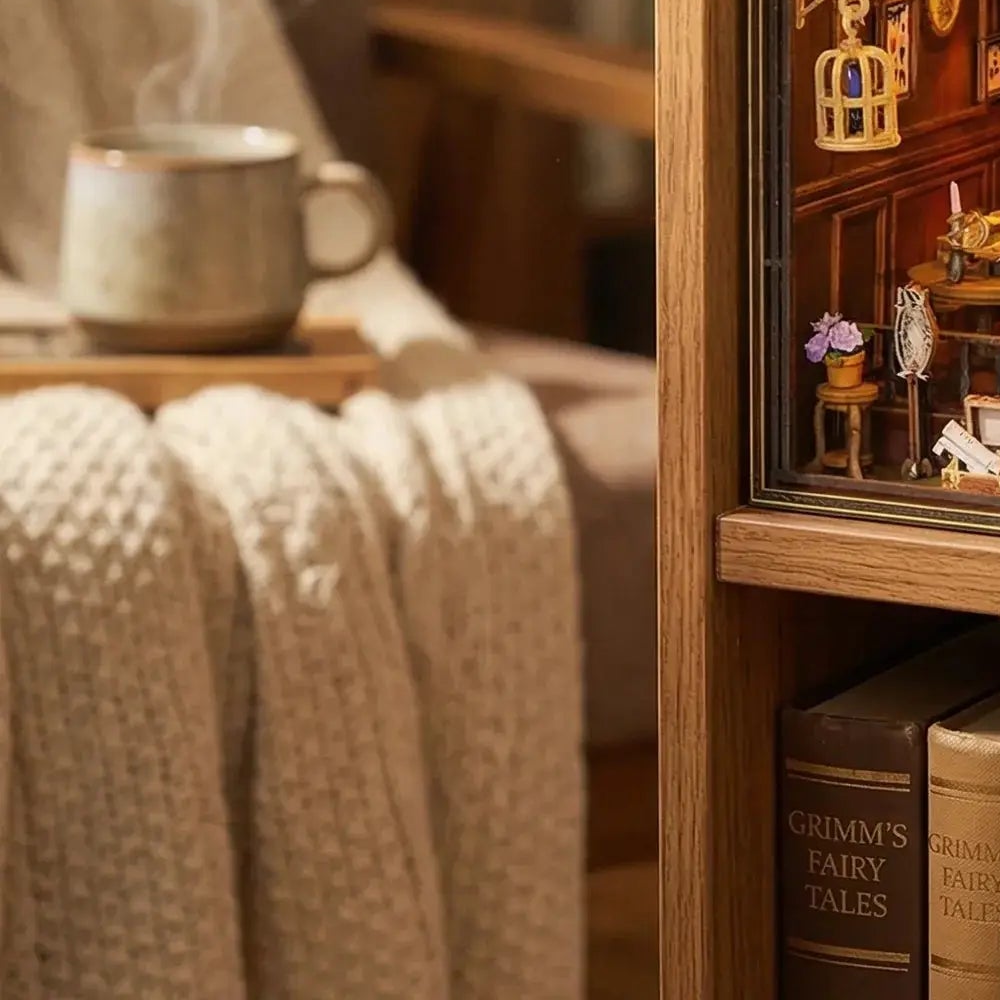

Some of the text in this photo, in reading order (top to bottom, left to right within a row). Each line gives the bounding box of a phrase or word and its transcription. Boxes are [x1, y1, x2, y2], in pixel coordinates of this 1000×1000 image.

[788, 810, 908, 849] GRIMM'S
[808, 848, 887, 882] FAIRY
[804, 884, 888, 918] TALES
